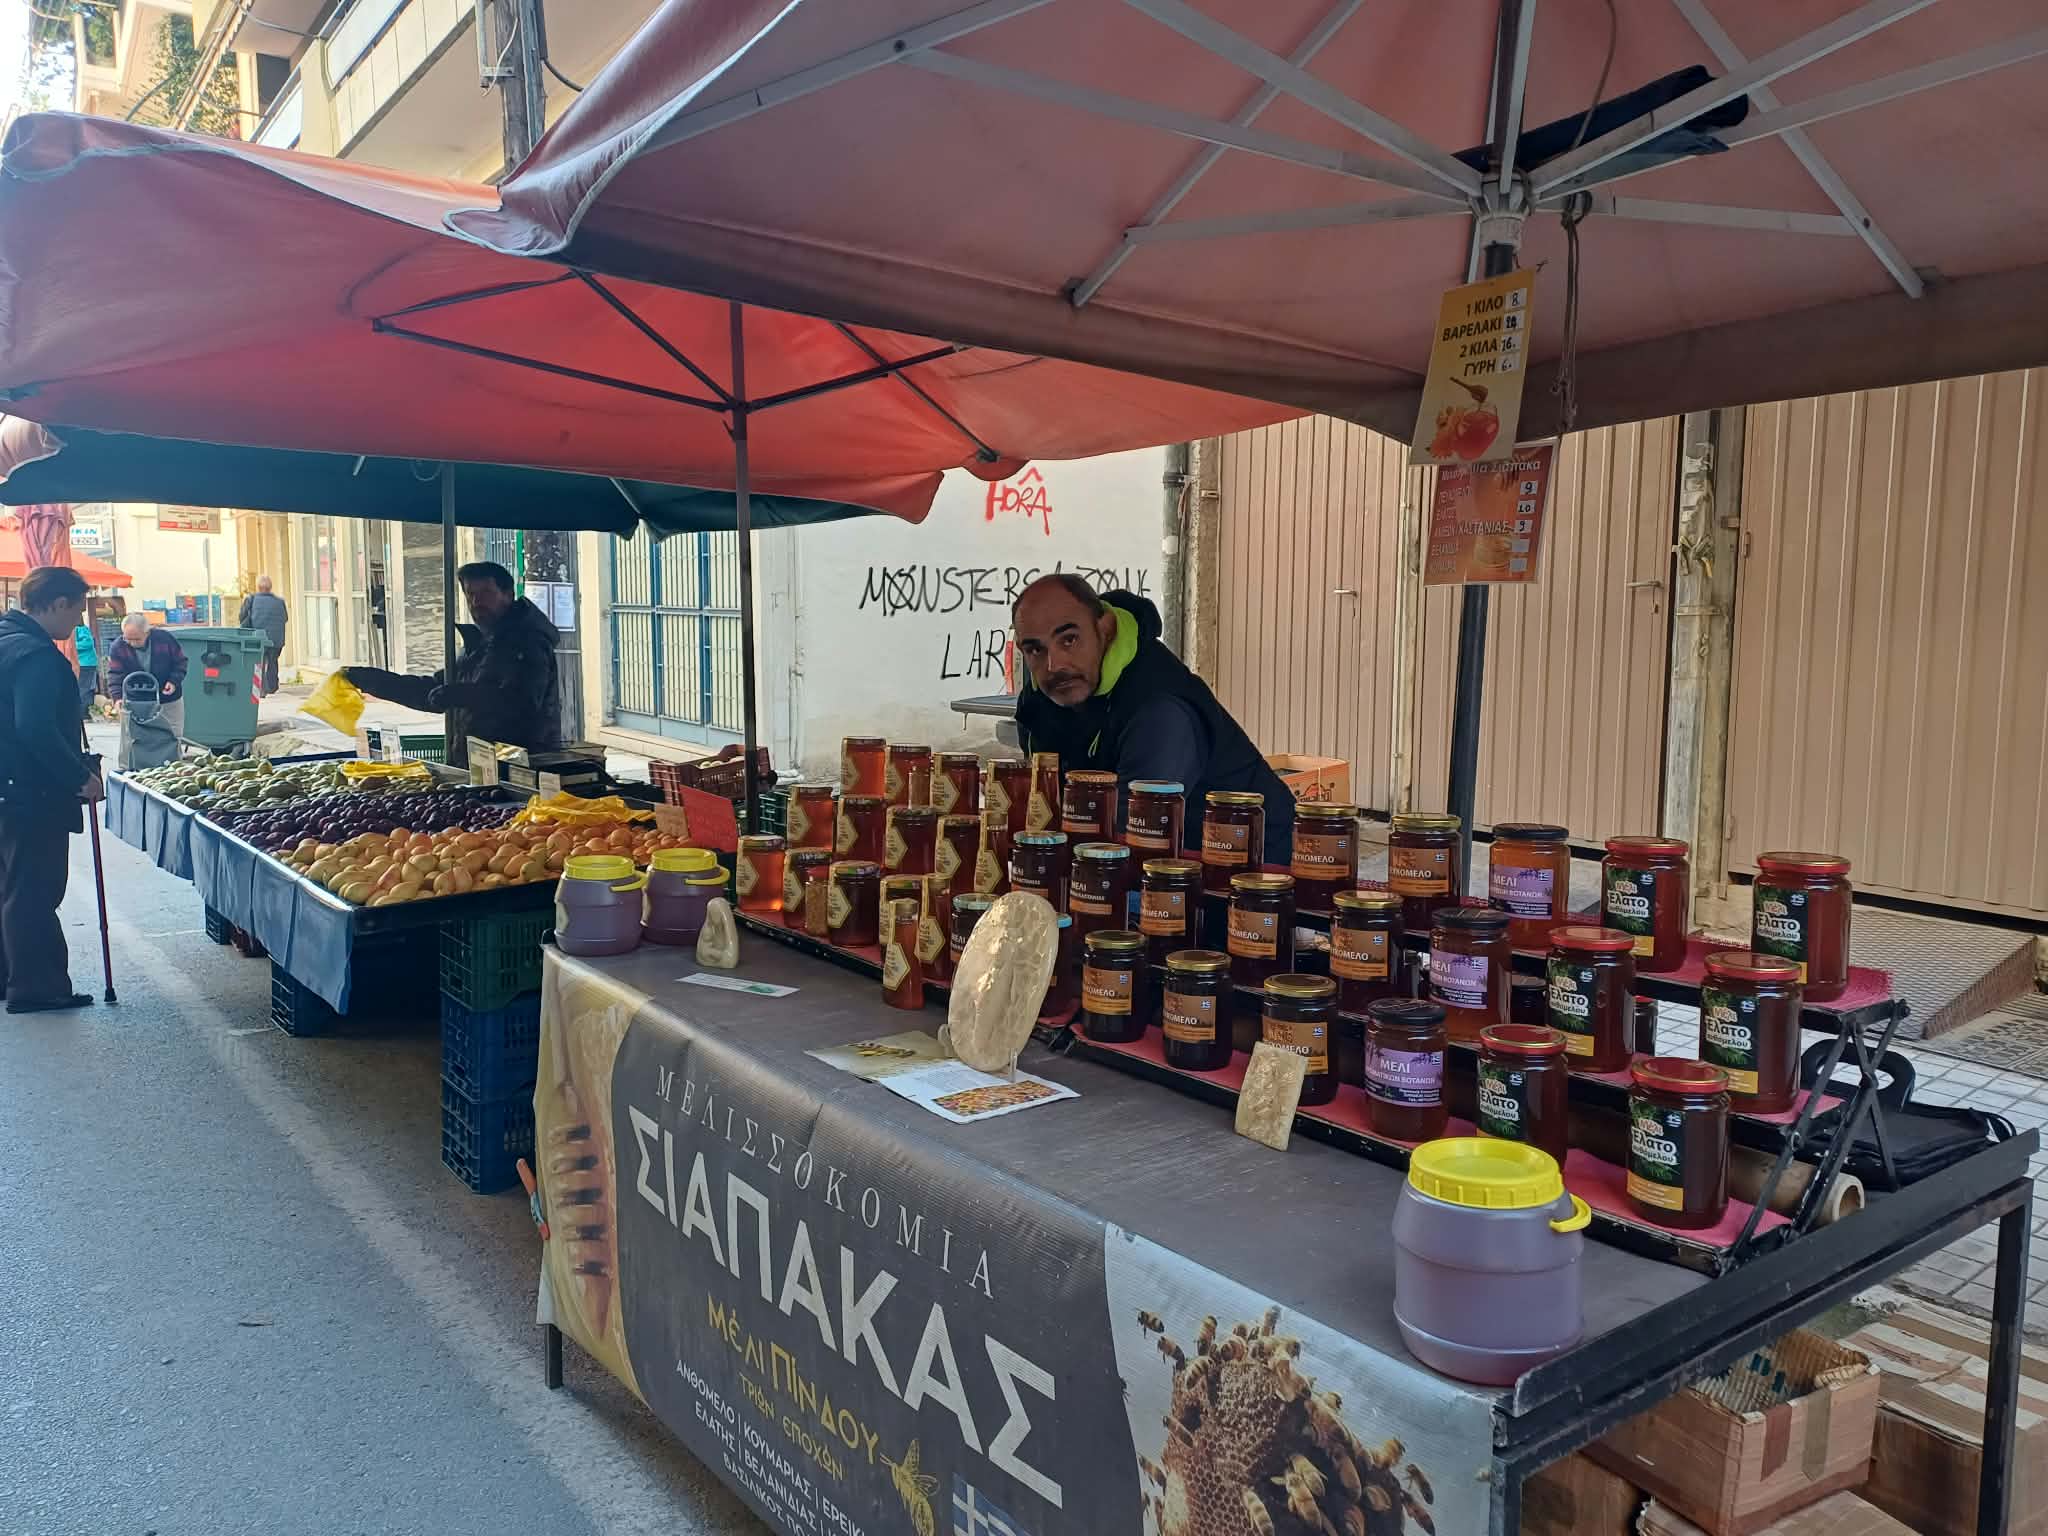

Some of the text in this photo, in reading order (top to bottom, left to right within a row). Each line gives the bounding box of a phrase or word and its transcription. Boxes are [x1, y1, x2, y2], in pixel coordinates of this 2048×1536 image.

[1474, 295, 1504, 315] ΚΙΛΟ
[1442, 316, 1502, 342] ΒΑΡΕΛΑΚΙ
[1460, 344, 1467, 358] 2
[1470, 338, 1498, 356] ΚΙΛΑ
[1464, 358, 1497, 377] ΓΥΡΗ
[1525, 481, 1532, 494] 9
[1519, 521, 1525, 532] 9
[1380, 1059, 1410, 1074] ΜΕΛΙ
[655, 1064, 994, 1299] ΜΕΛΙΣΣΟΚΟΜΙΑ
[628, 1103, 1063, 1510] ΣΙΑΠΑΚΑΣ
[675, 1359, 735, 1425] ΑΝΘΟΜΕΛΟ
[743, 1420, 812, 1500] ΚΟΥΜΑΡΙΑΣ
[695, 1400, 817, 1532] ΕΛΑΤΗΣ ΒΕΛΑΝΙΔΙΑΣ
[723, 1453, 785, 1522] ΒΑΣΙΛΙΚΟΣ
